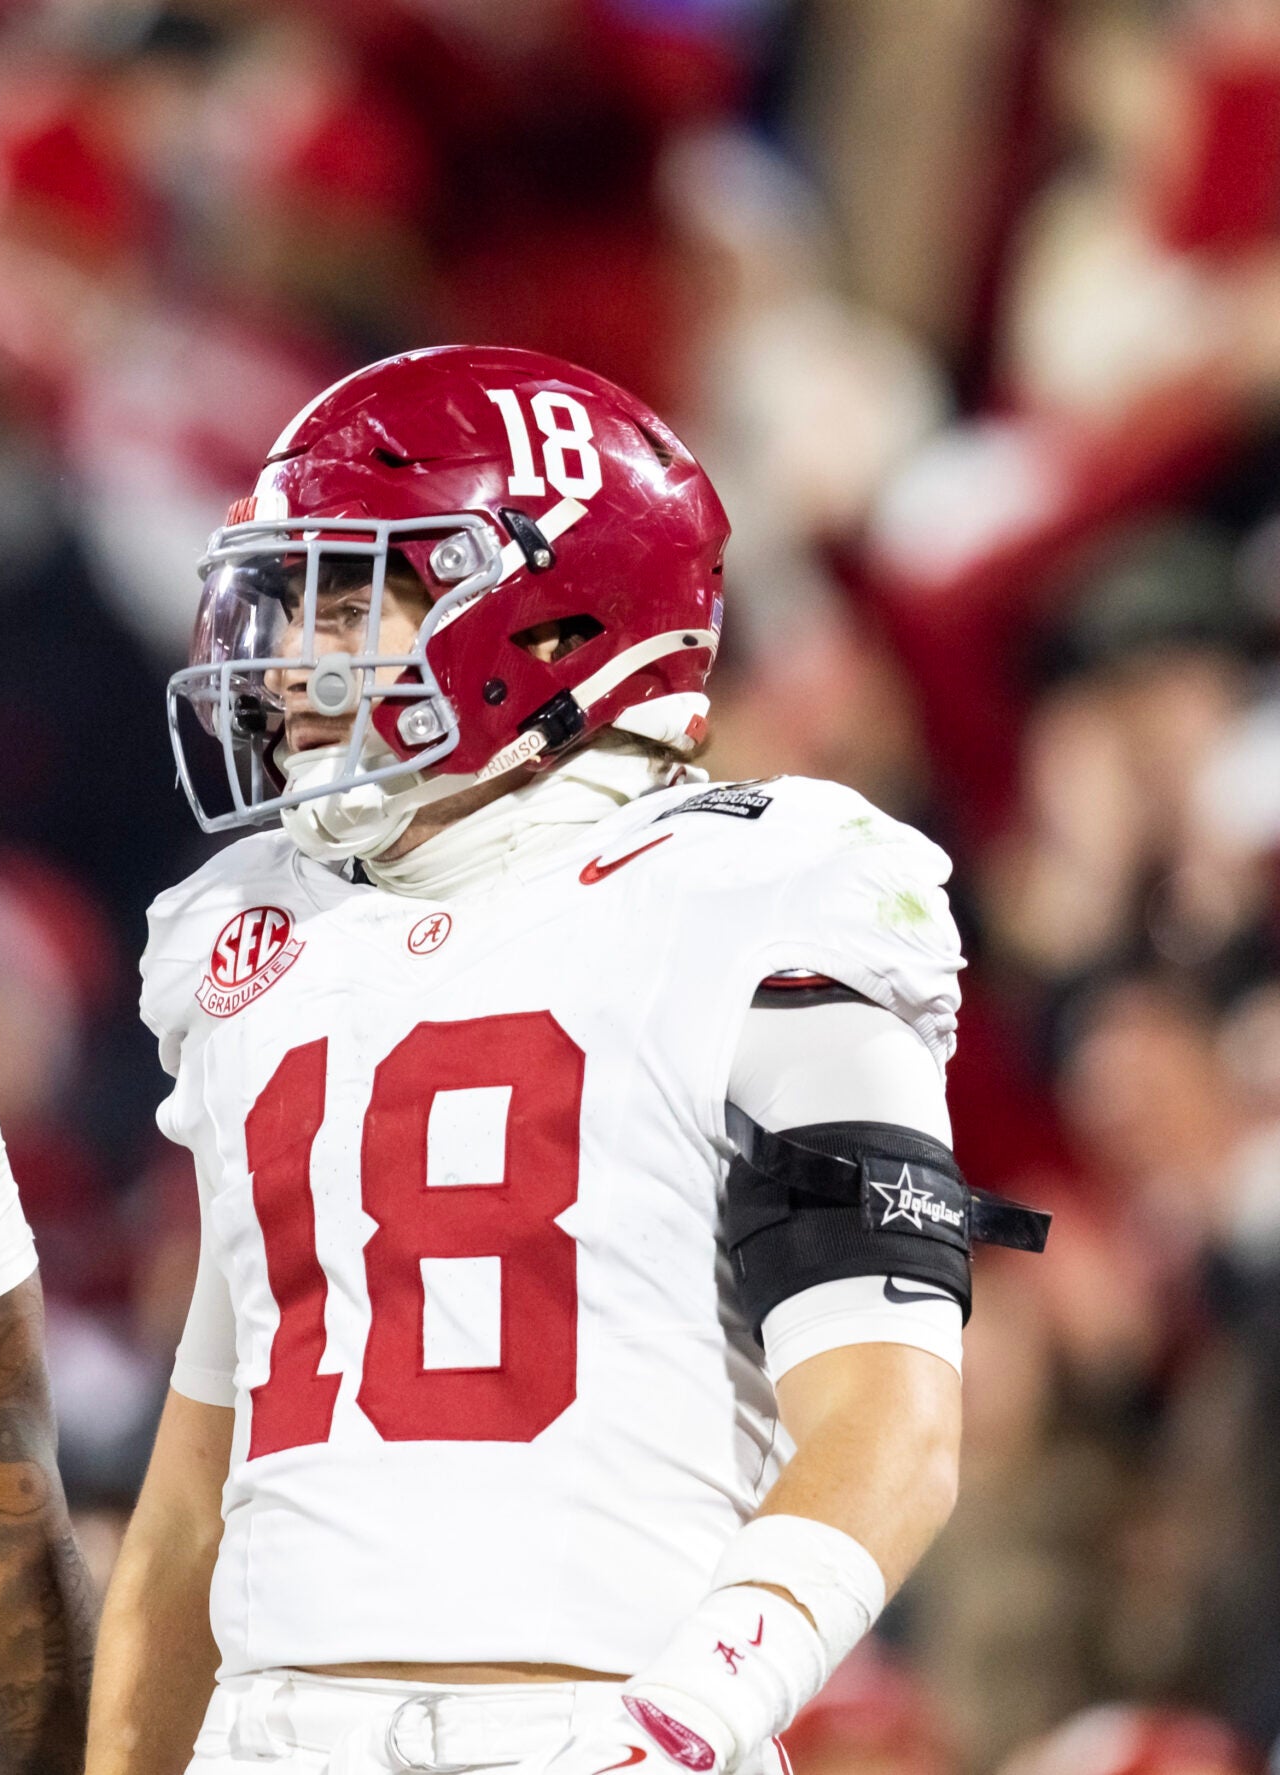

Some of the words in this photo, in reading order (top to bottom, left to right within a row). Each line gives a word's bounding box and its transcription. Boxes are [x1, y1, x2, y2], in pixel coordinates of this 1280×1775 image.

[485, 389, 603, 500] 18
[475, 734, 546, 779] RIMSO
[216, 909, 287, 984] SEC
[207, 960, 285, 1013] GRADUATE
[244, 1009, 587, 1463] 18
[898, 1189, 961, 1227] Douglas
